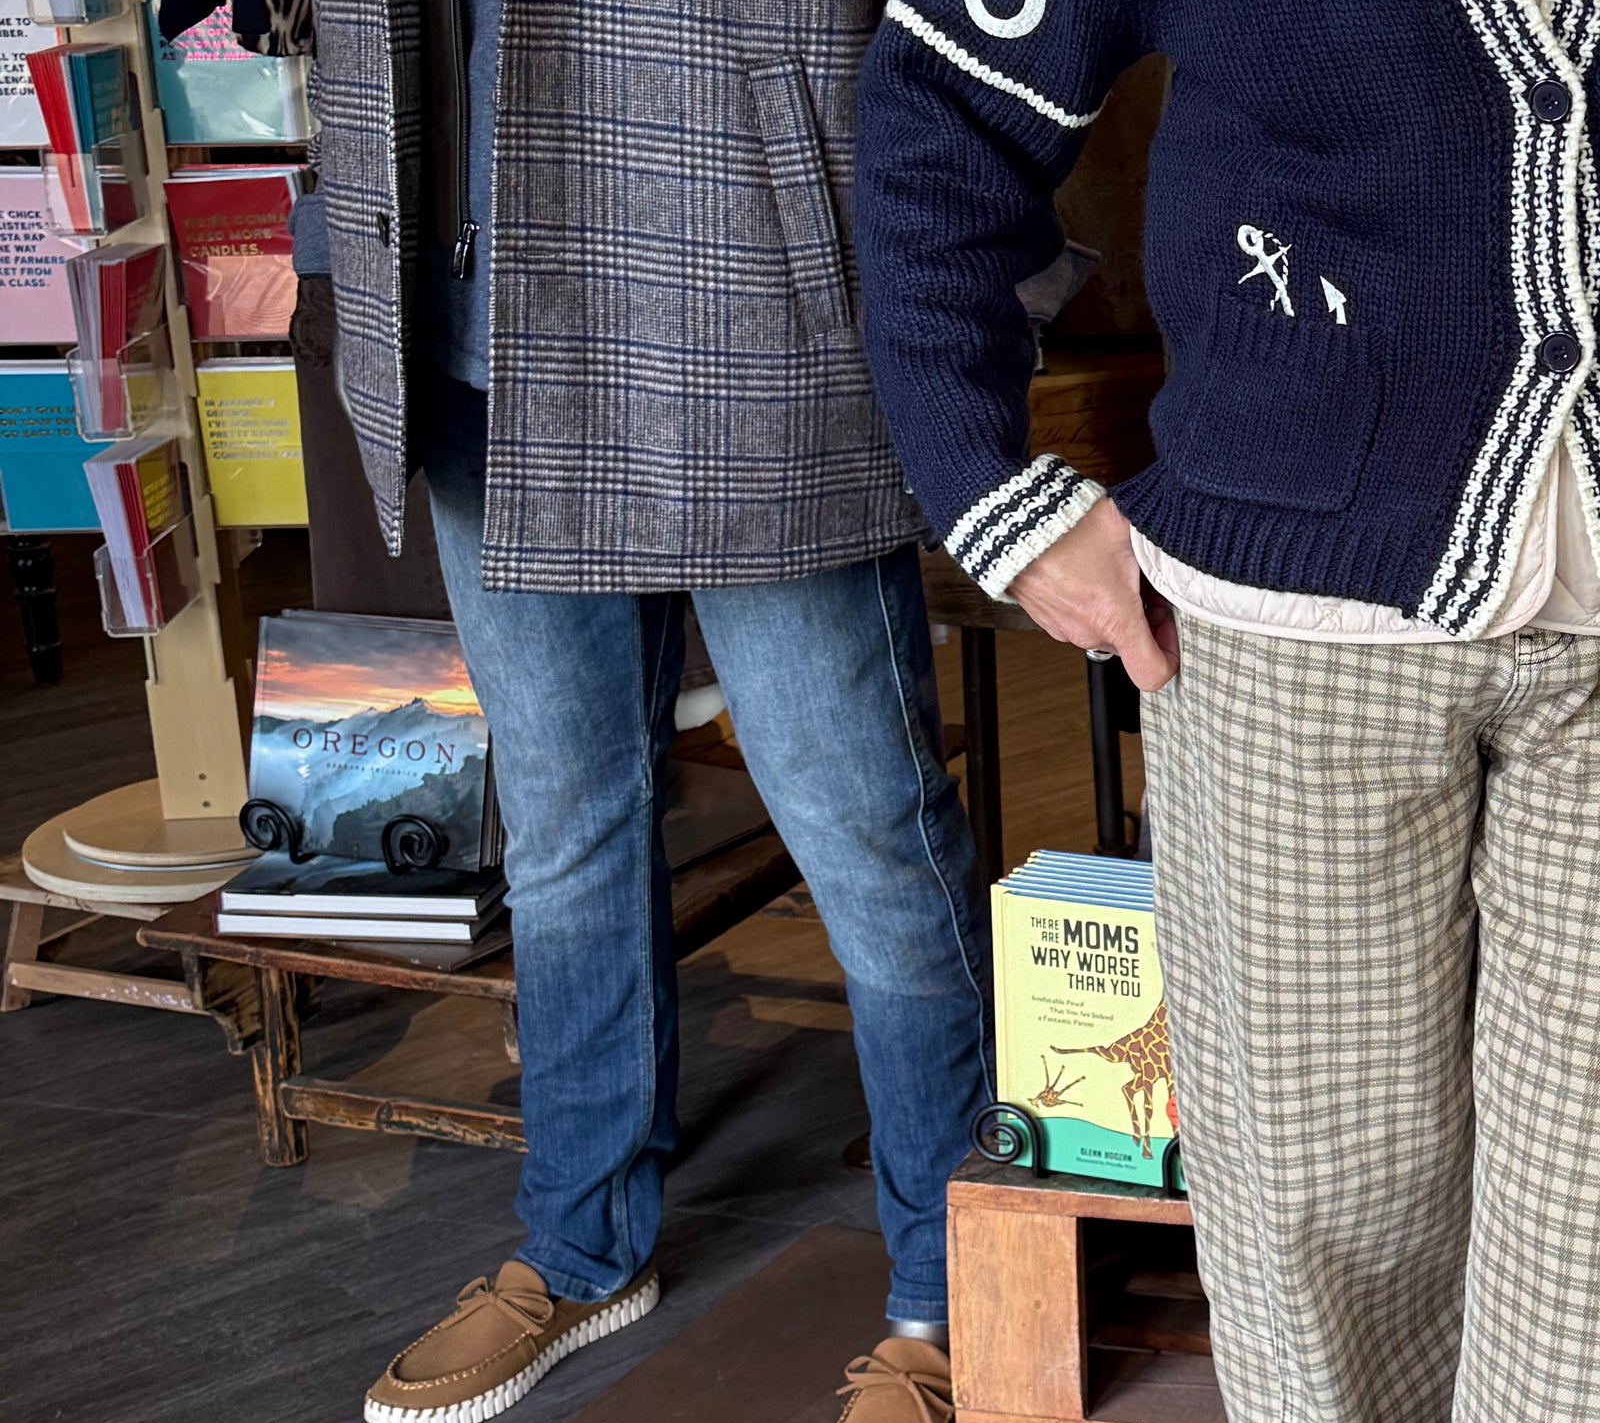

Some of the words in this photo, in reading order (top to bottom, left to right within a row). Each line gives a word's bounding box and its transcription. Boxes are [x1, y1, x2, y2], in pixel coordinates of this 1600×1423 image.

[16, 18, 31, 26] TO
[8, 210, 42, 218] CHICK
[187, 231, 224, 242] NEED
[230, 228, 272, 240] MORE
[190, 244, 264, 257] CANDLES.
[15, 256, 65, 264] FARMERS
[9, 279, 49, 287] CLASS.
[293, 728, 455, 764] OREGON
[1031, 917, 1059, 930] THERE
[1064, 919, 1138, 954] MOMS
[1042, 932, 1059, 943] ARE
[1031, 946, 1070, 969] WAY
[1076, 951, 1139, 978] WORSE
[1067, 973, 1105, 993] THAN
[1110, 979, 1140, 998] YOU
